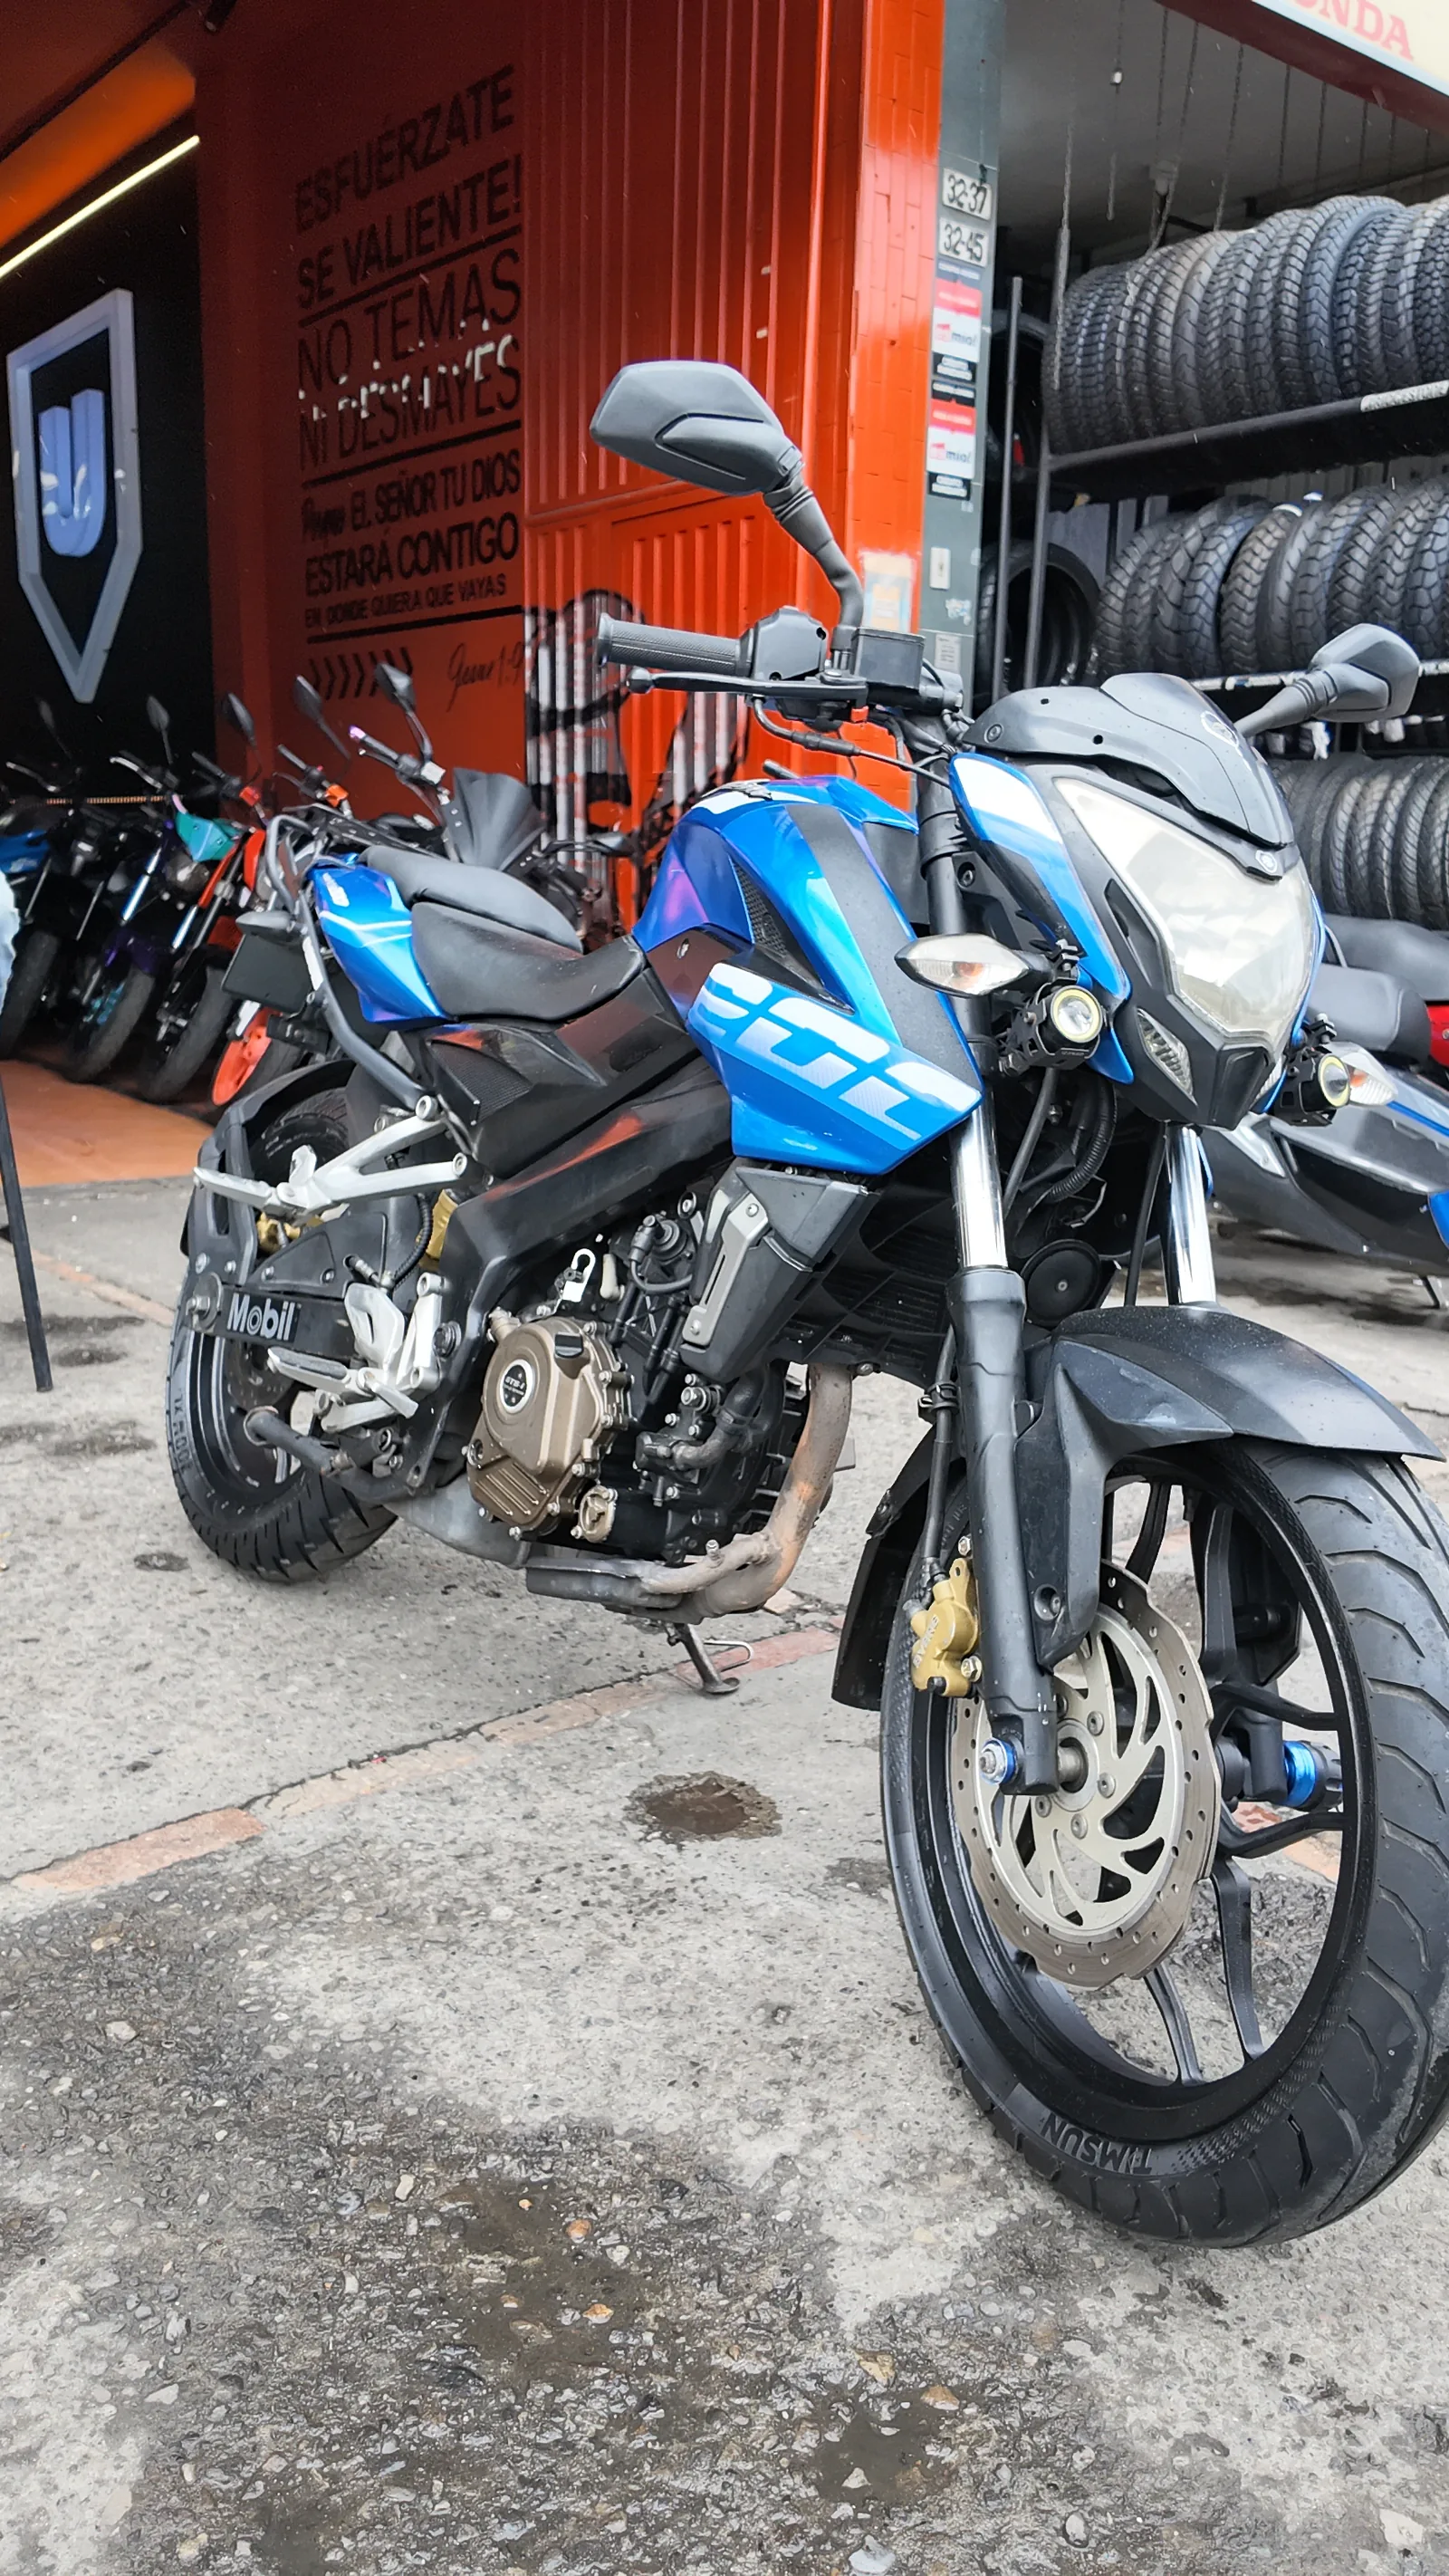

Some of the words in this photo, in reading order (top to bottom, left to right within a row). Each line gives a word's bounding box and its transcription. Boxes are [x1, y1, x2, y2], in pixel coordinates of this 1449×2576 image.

[1295, 0, 1415, 62] NDA
[296, 245, 334, 310] SE
[342, 153, 522, 286] VALIENTE!
[944, 223, 984, 262] 32-45
[298, 319, 351, 400] NO
[364, 247, 522, 370] TEMAS
[338, 333, 521, 459] DESMAYES
[350, 489, 372, 533] EL
[375, 470, 437, 524] SEÑOR
[440, 464, 467, 510] TU
[471, 448, 522, 503] DIOS
[304, 527, 394, 598] ESTARÁ
[397, 512, 519, 580] CONTIGO
[304, 607, 321, 629] EN
[326, 598, 369, 625] DONDE
[370, 591, 422, 617] QUIERA
[426, 582, 456, 609] QUE
[456, 572, 506, 602] VAYAS
[226, 1292, 296, 1341] Mobil
[1041, 2111, 1153, 2175] TIMSUN
